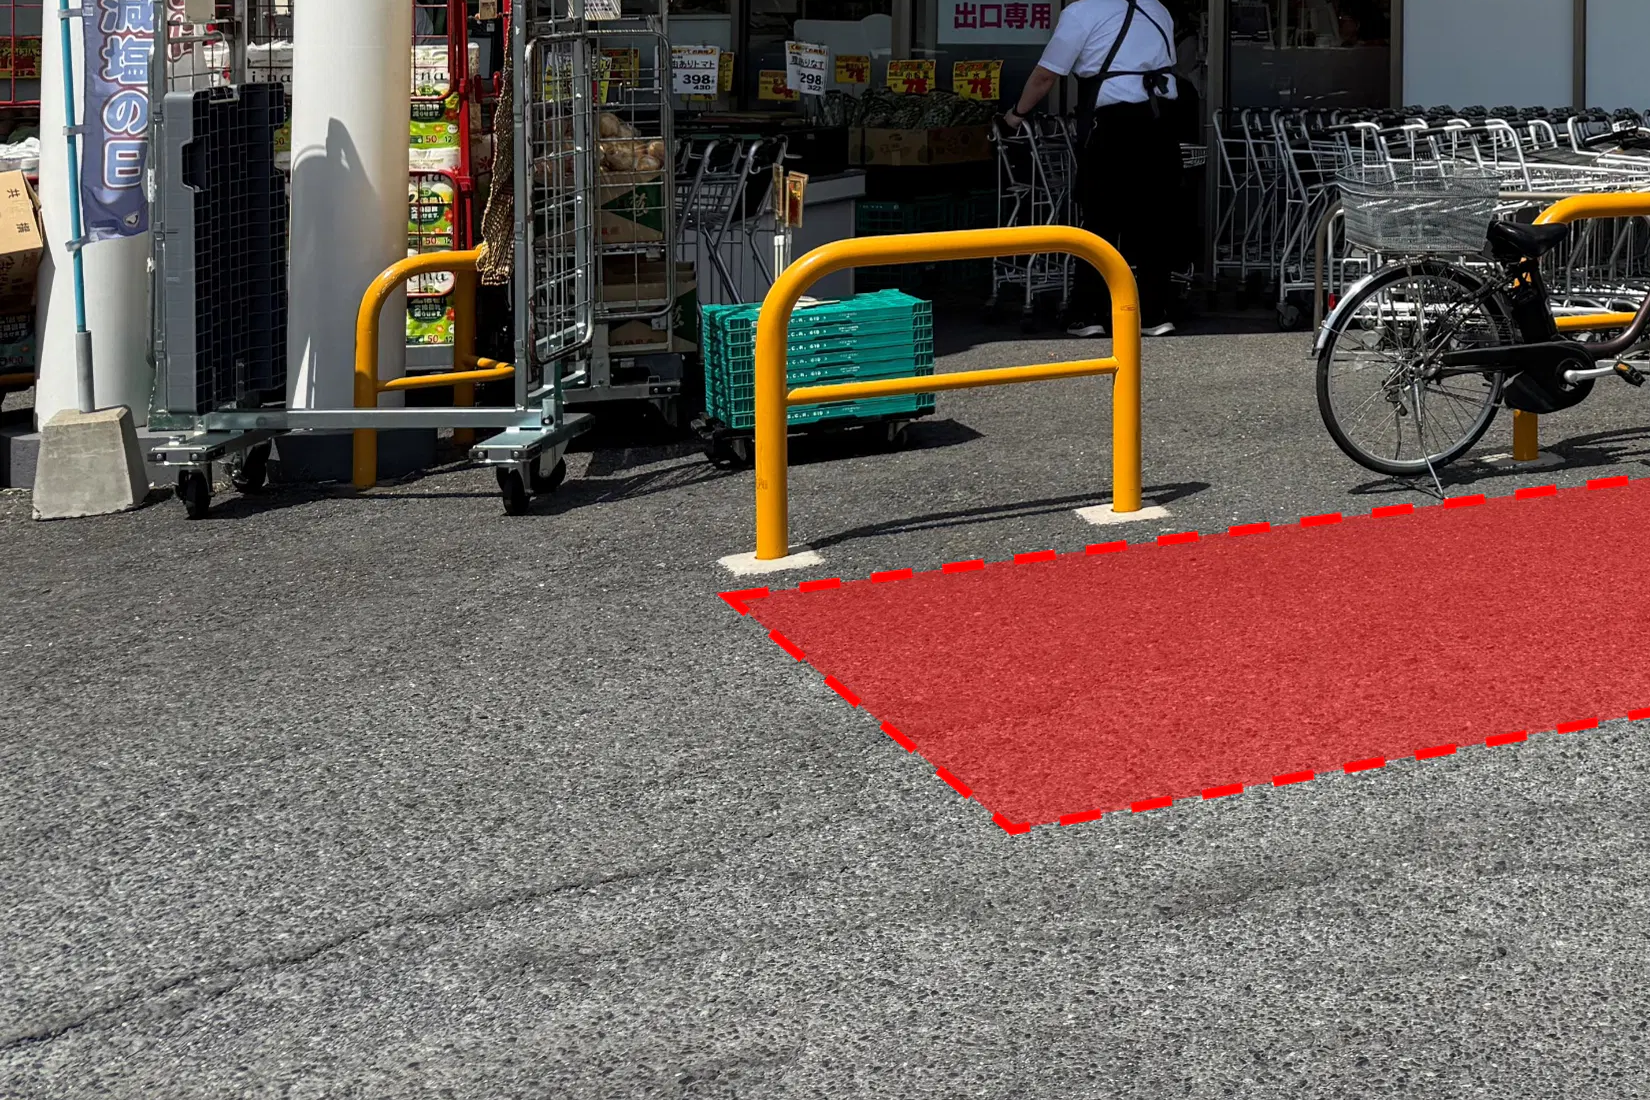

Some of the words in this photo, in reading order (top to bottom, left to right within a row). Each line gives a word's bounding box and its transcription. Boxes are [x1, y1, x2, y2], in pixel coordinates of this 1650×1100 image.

[954, 2, 1051, 29] 出口専用
[682, 74, 711, 84] 398
[800, 73, 822, 85] 298
